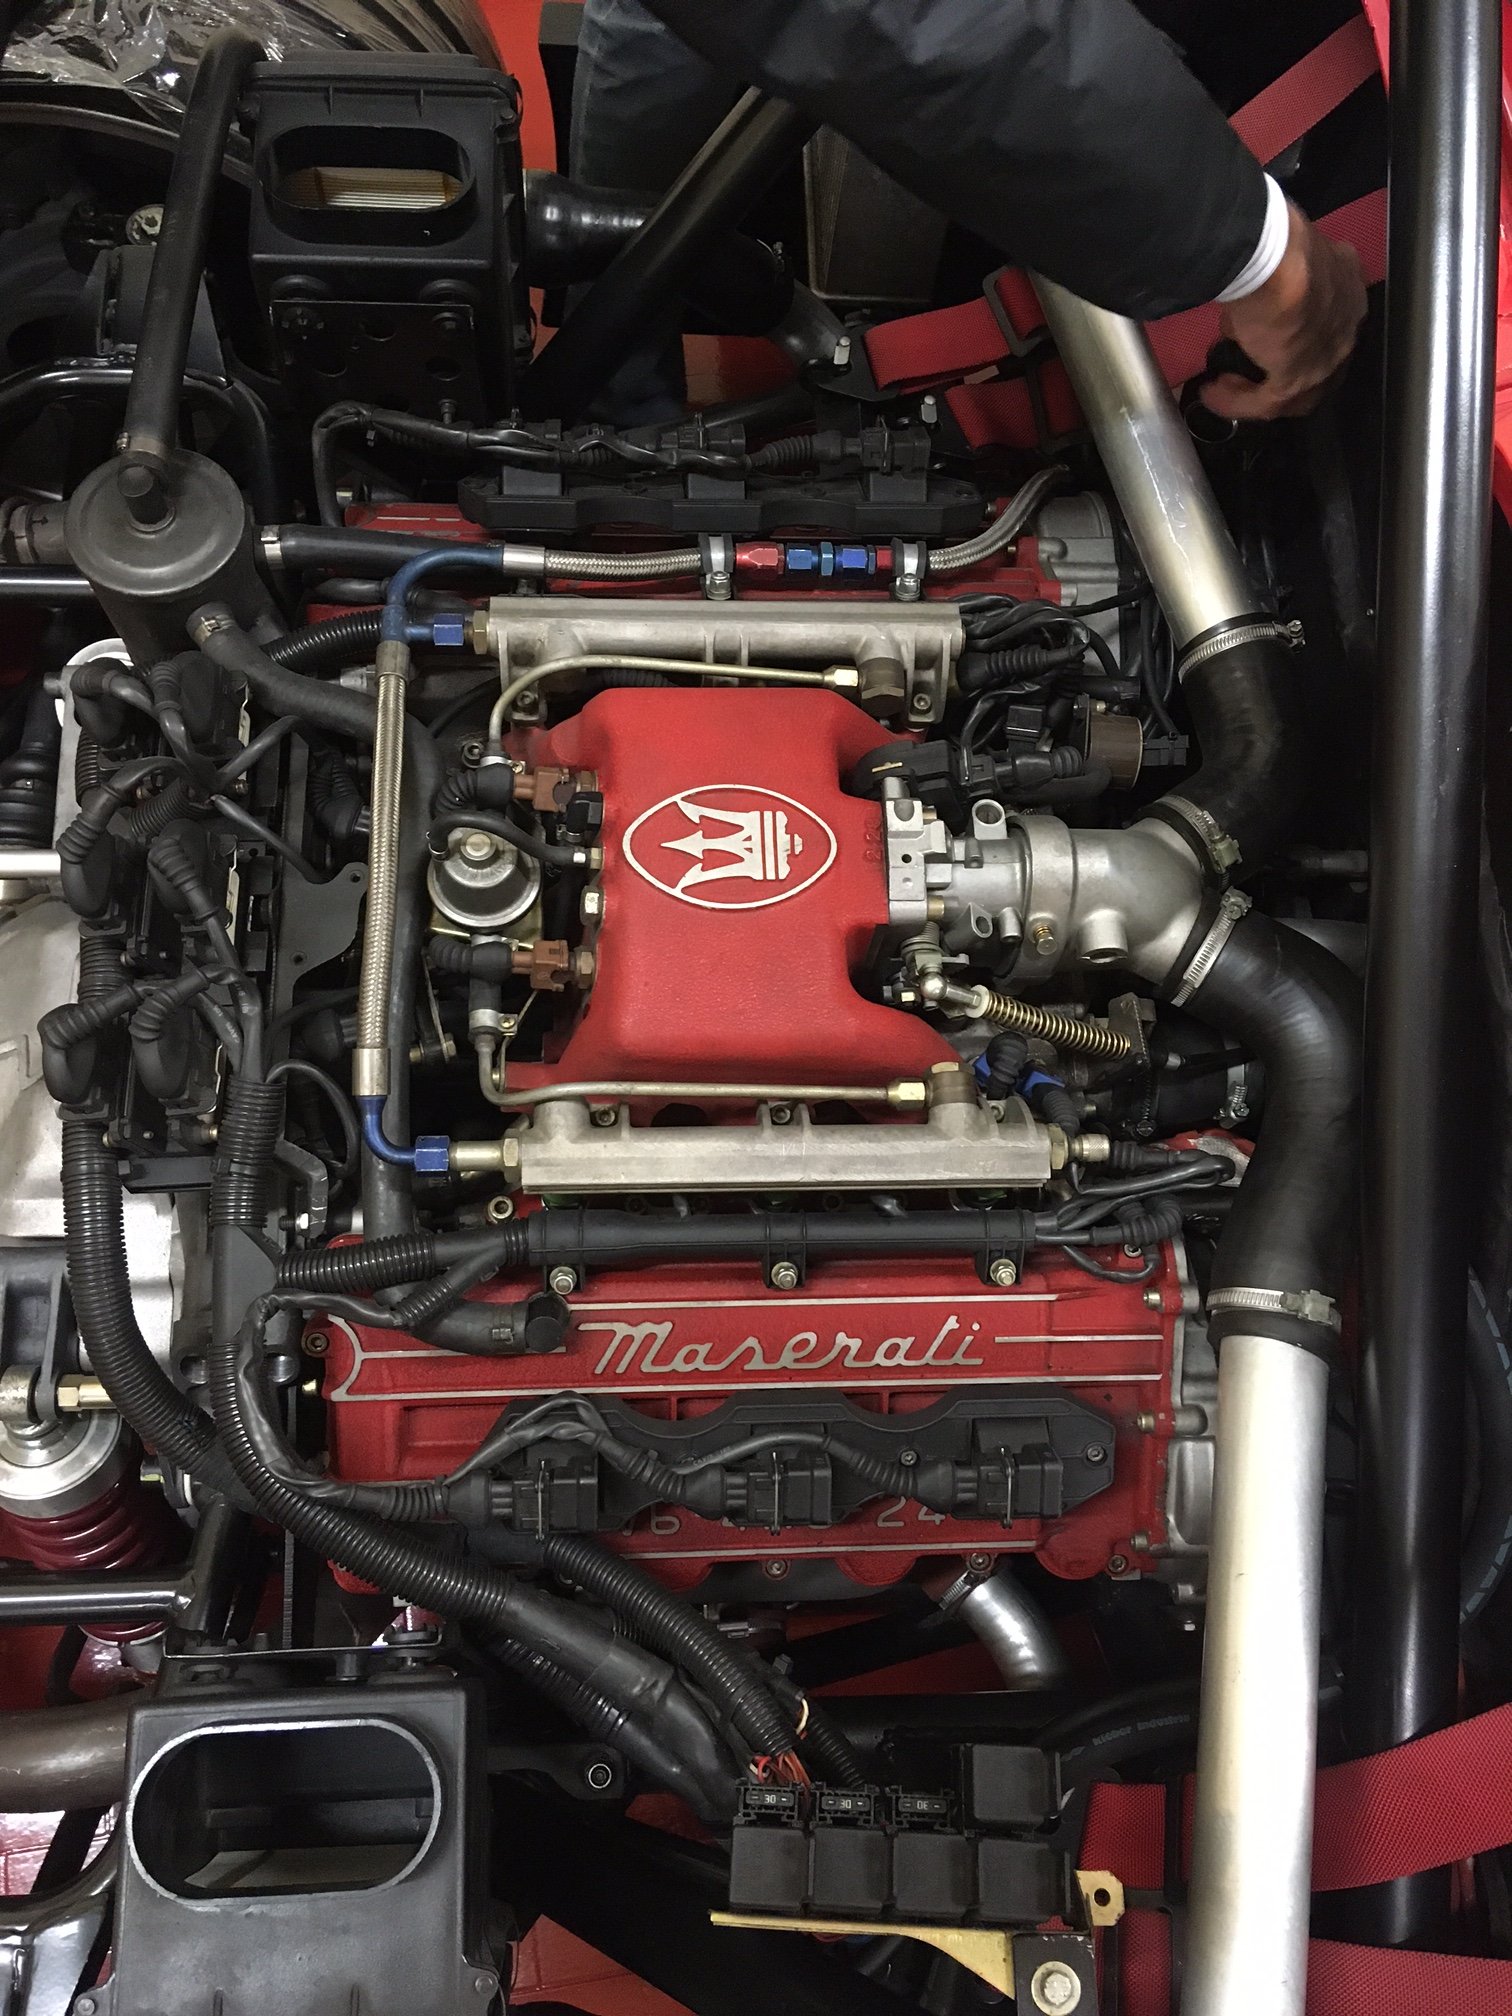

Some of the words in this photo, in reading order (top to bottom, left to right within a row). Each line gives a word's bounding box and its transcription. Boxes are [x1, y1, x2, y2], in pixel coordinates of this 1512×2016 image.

[577, 1314, 984, 1375] Maserati
[763, 1794, 777, 1804] 30
[839, 1798, 852, 1809] 30
